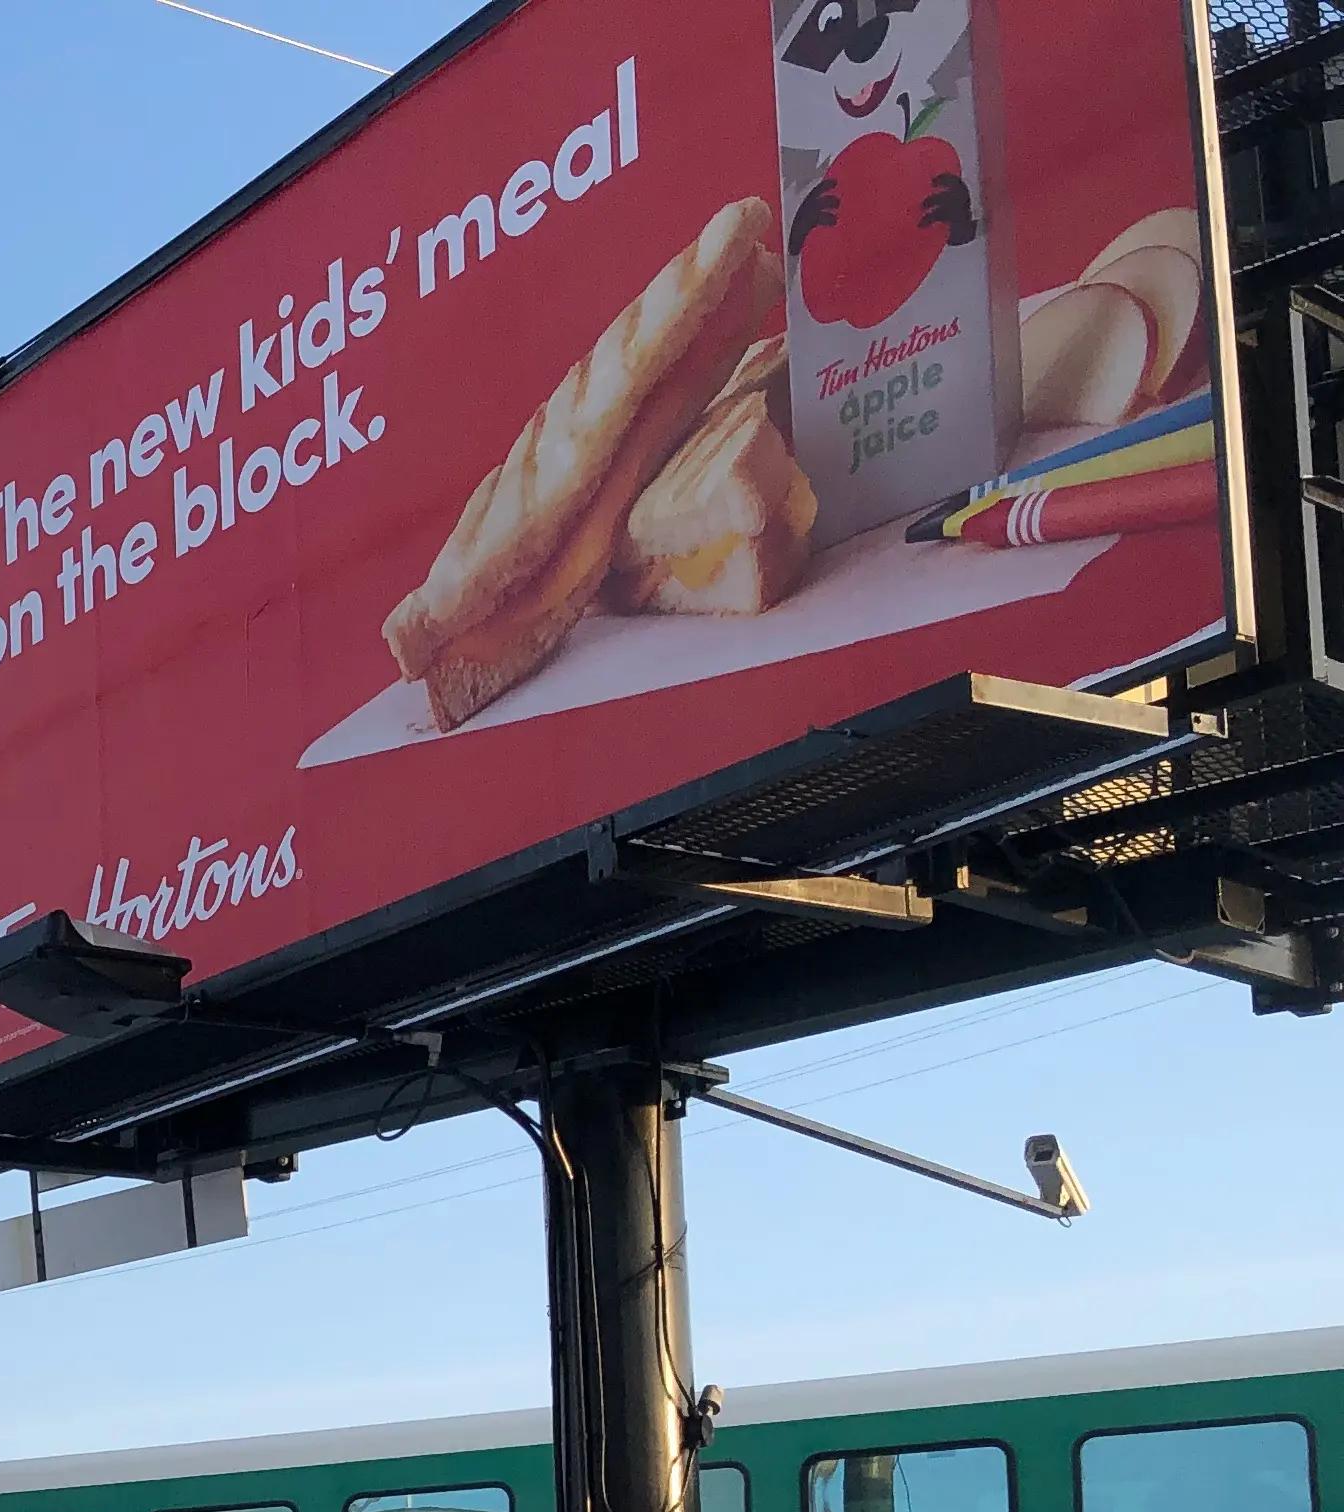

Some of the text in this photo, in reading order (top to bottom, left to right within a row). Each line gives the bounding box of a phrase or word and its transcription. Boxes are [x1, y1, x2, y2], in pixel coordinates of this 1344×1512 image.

[89, 367, 224, 509] new
[417, 55, 639, 298] meal
[816, 316, 961, 401] Tim Hortons
[839, 361, 944, 426] apple
[849, 409, 940, 475] juice
[56, 521, 158, 625] the
[173, 370, 386, 557] block.
